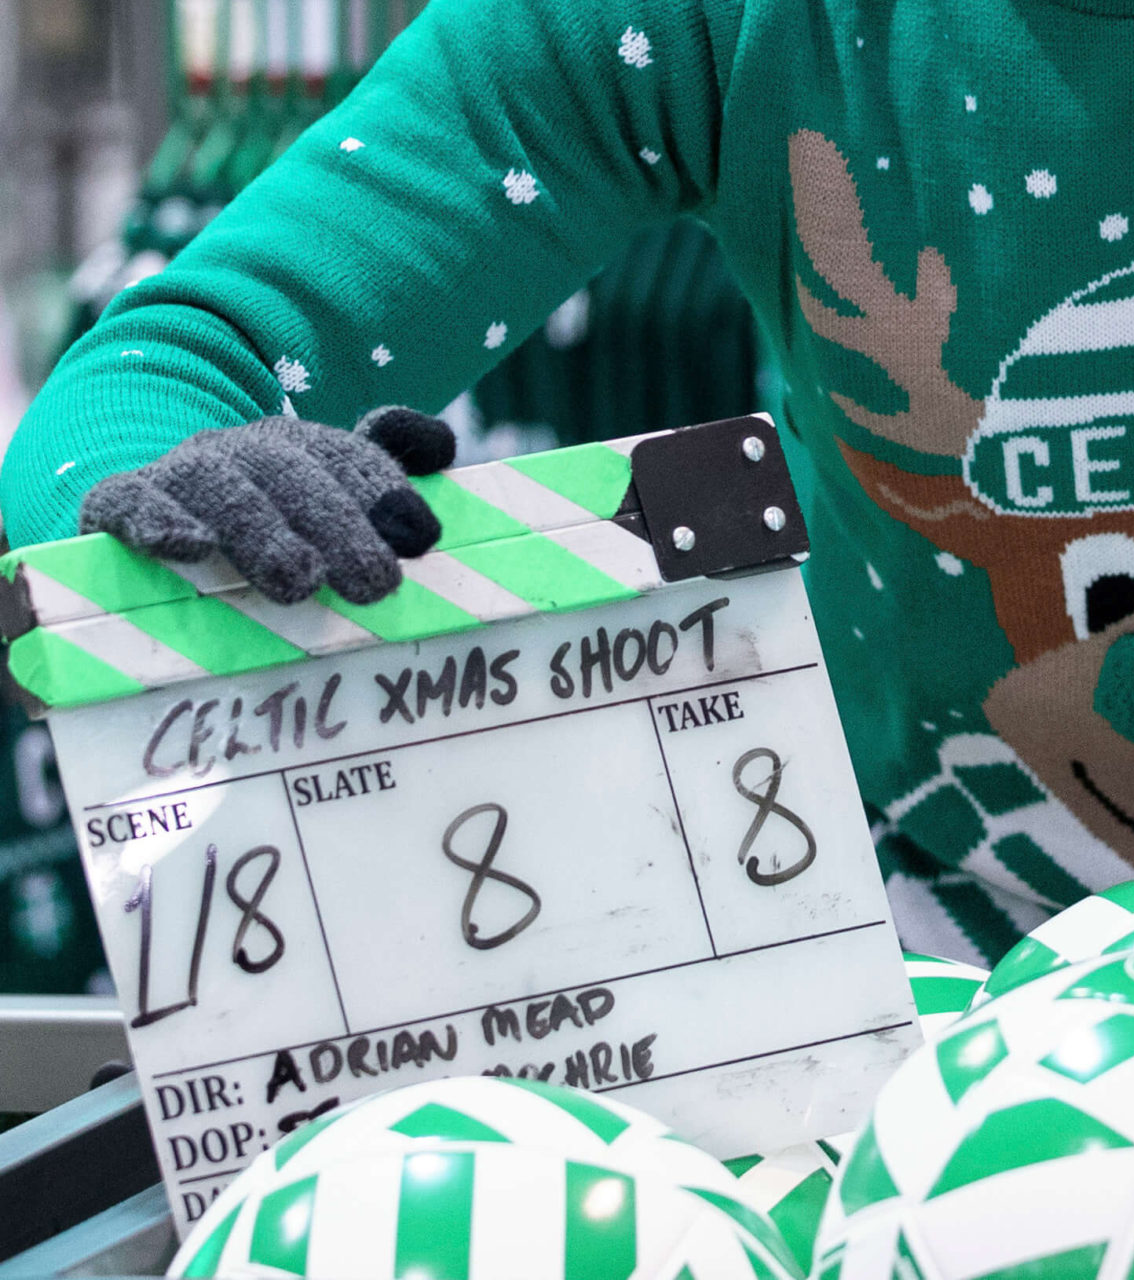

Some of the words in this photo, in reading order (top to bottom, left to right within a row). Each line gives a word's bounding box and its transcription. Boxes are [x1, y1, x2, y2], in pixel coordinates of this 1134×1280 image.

[376, 644, 519, 724] XMAS
[548, 596, 730, 699] SHOOT
[656, 692, 746, 733] TAKE
[292, 760, 397, 808] SLATE
[86, 802, 194, 847] SCENE
[730, 746, 818, 887] 8
[441, 802, 542, 951] 8
[266, 1025, 458, 1105] ADRIAN
[480, 986, 616, 1045] MEAD
[155, 1074, 245, 1123] DIR:
[169, 1122, 270, 1171] DOP:
